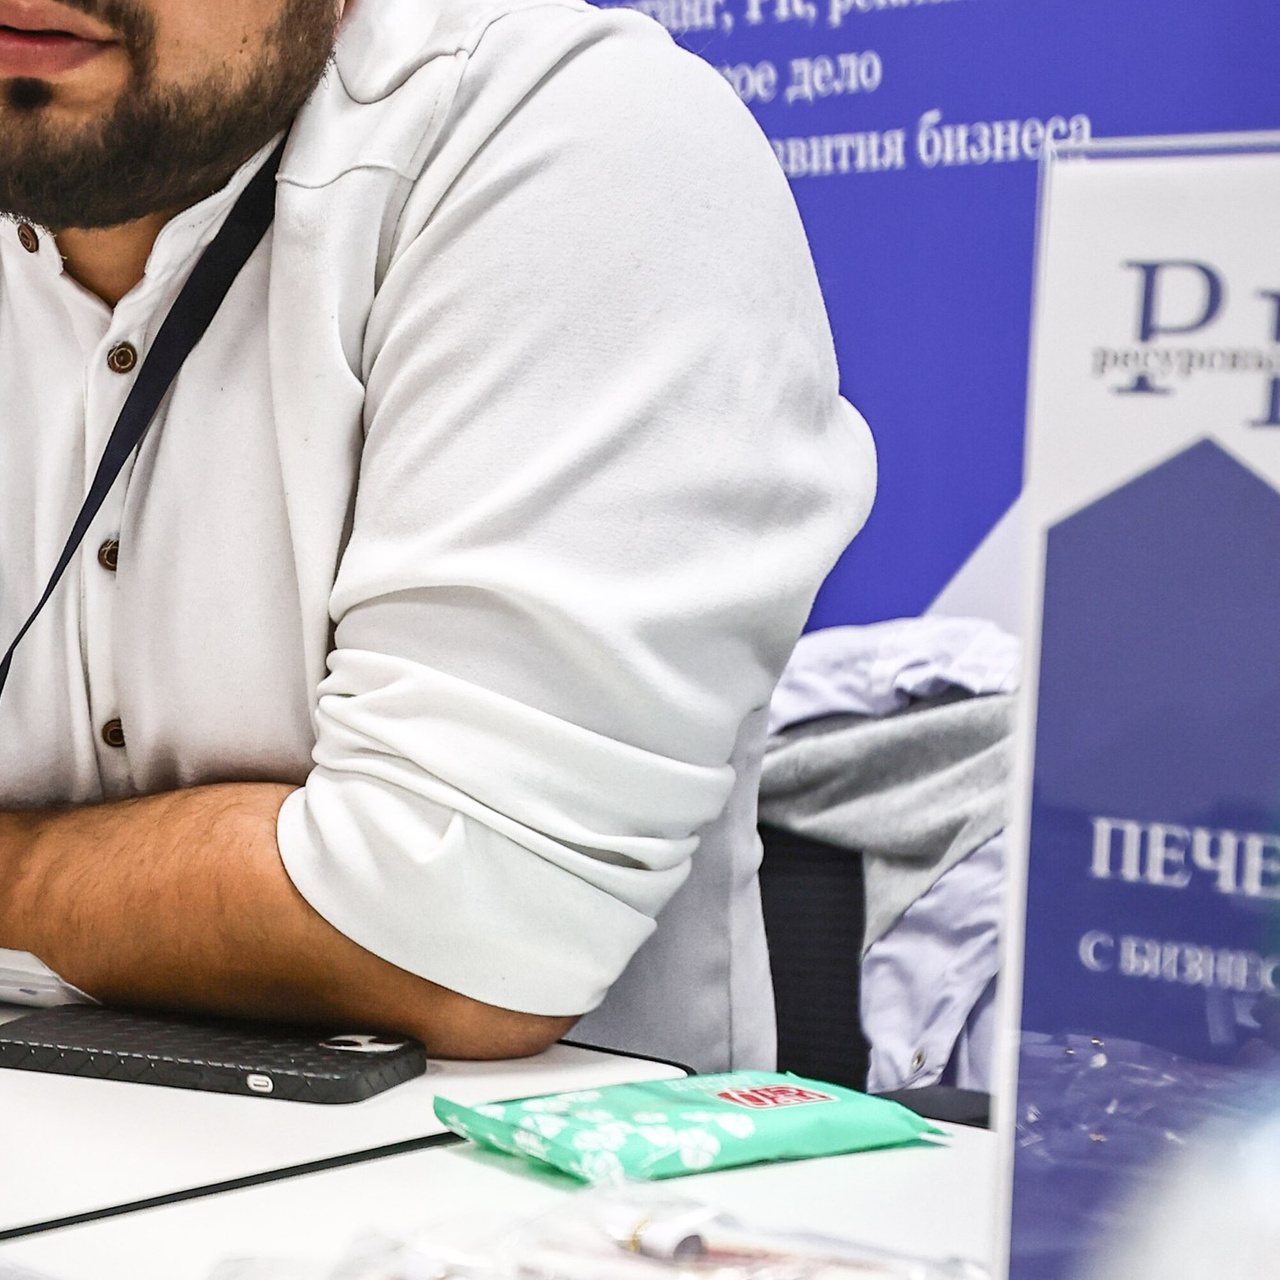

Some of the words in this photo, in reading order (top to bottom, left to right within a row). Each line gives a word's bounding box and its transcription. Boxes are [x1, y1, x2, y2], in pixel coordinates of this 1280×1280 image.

[716, 61, 778, 102] ое
[785, 50, 882, 104] дело
[1089, 817, 1280, 898] ПЕЧЕ
[1078, 929, 1114, 972] С
